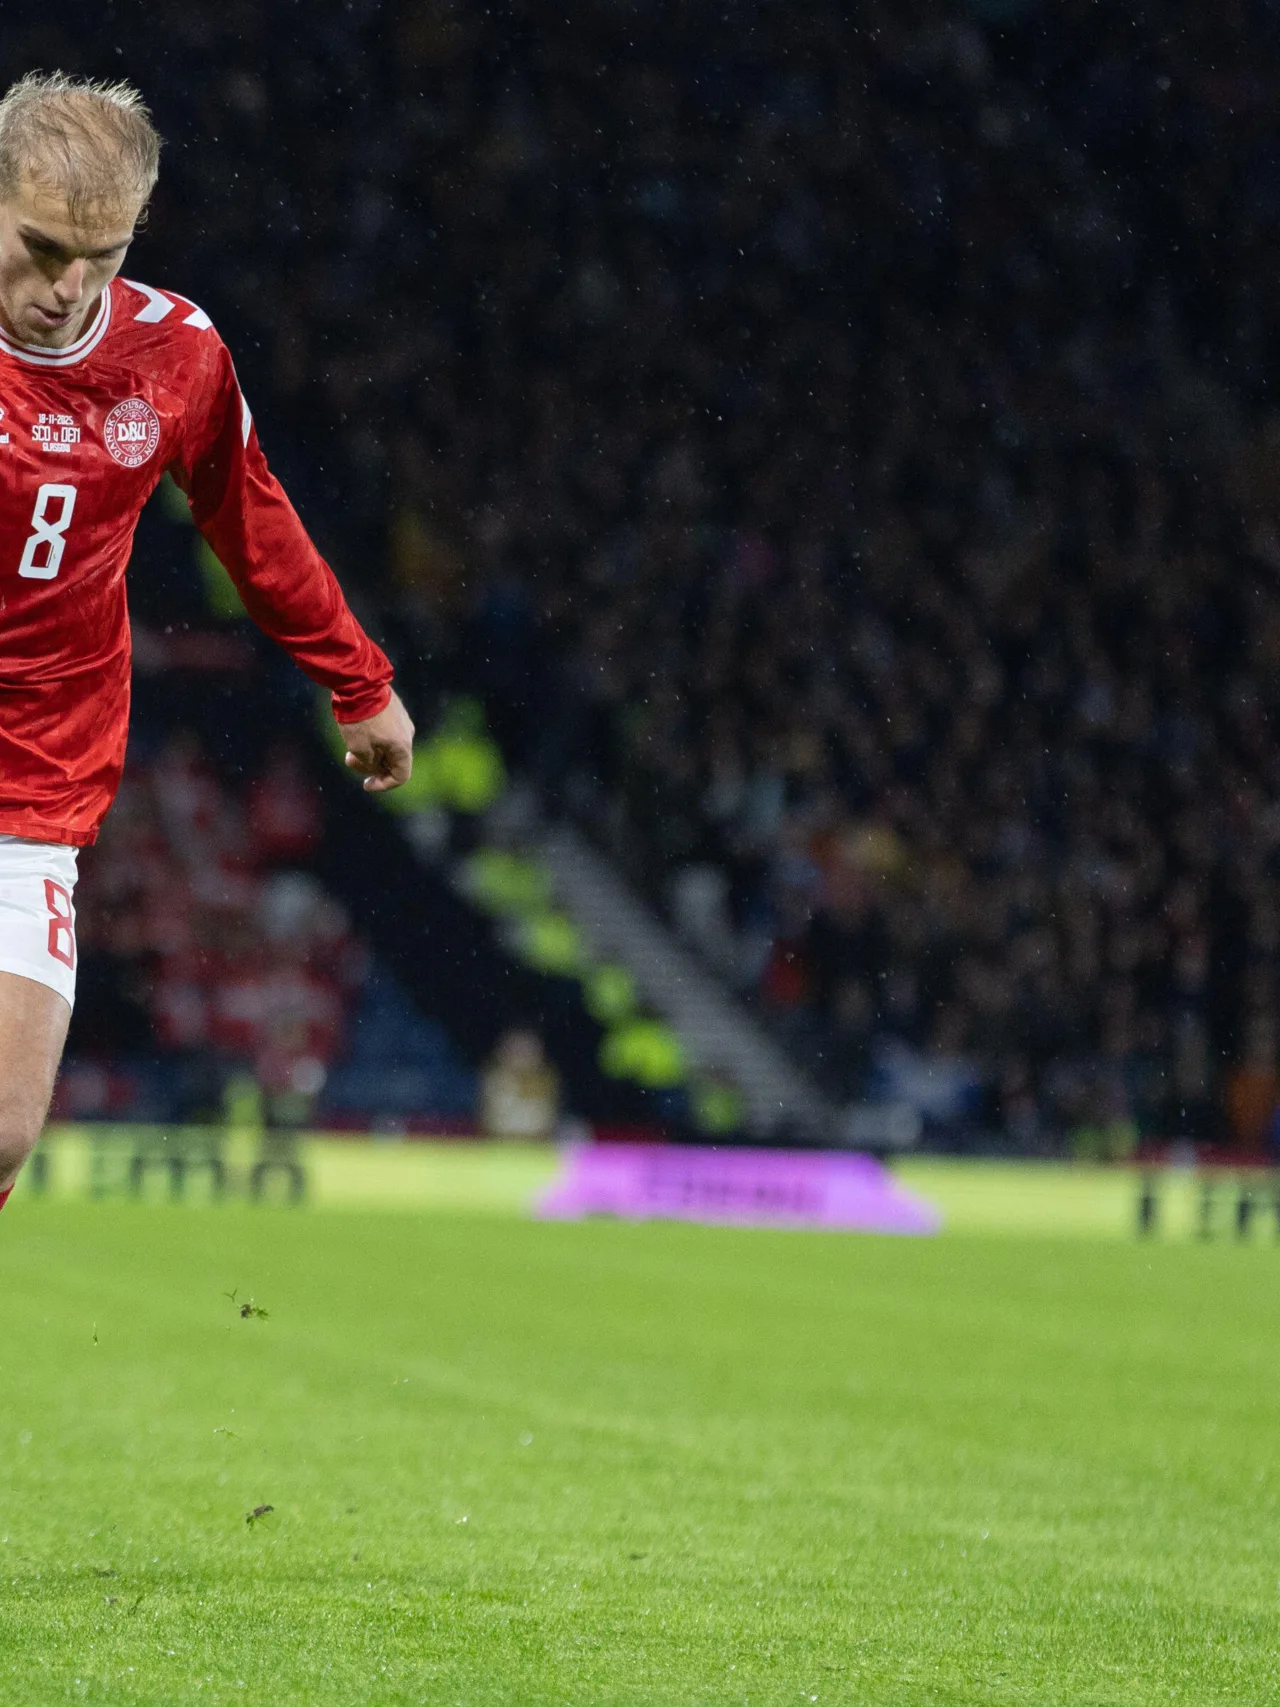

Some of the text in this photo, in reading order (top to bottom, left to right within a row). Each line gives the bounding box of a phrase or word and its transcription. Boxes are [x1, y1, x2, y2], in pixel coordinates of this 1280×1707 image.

[32, 425, 51, 442] SCO
[61, 426, 80, 443] DEN
[106, 419, 122, 458] DANSK
[144, 419, 157, 456] UNION
[117, 421, 147, 442] DBU
[123, 455, 143, 465] 1889
[18, 483, 77, 580] 8
[43, 878, 75, 970] 8
